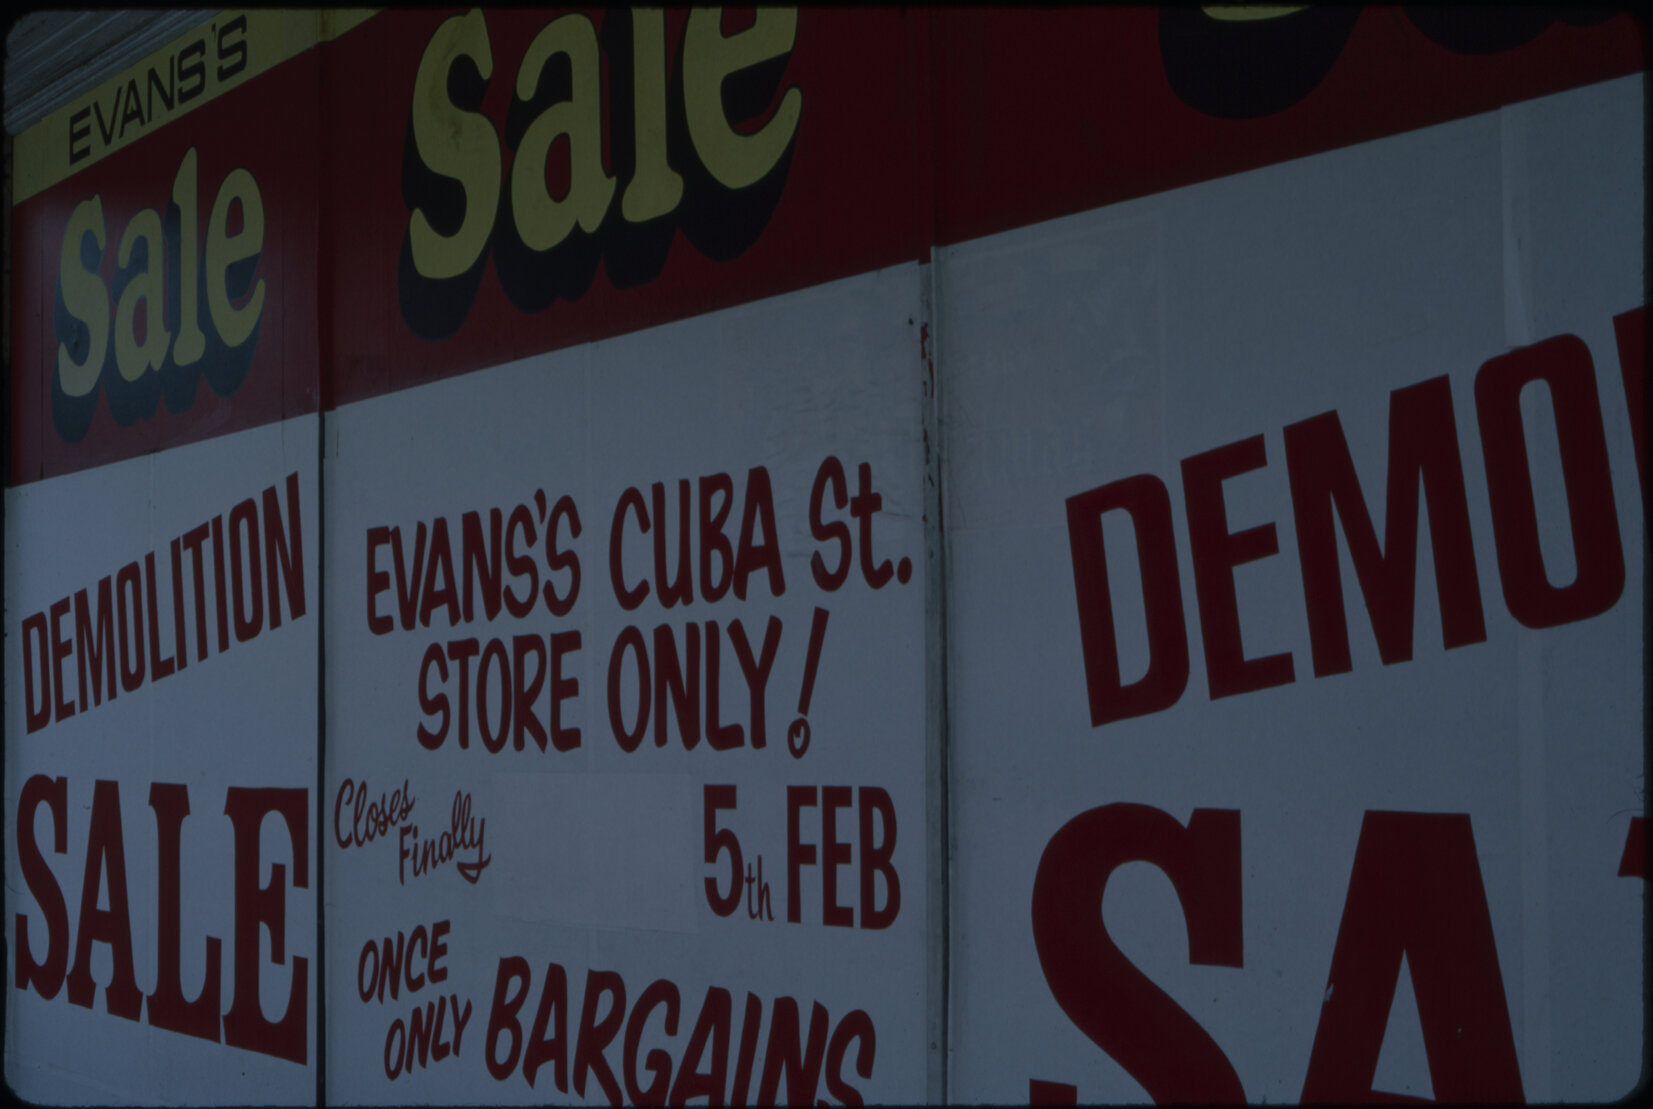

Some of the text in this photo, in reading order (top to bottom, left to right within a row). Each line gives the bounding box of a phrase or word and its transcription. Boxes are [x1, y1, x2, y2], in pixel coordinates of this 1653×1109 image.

[69, 14, 248, 166] EVANS'S
[408, 7, 802, 280] Sale
[57, 146, 266, 398] Sale
[367, 456, 912, 635] EVANS'S CUBA St.
[1066, 304, 1647, 727] DEMO
[21, 471, 306, 735] DEMOLITION
[417, 606, 829, 759] STORE ONLY!
[334, 778, 416, 849] Closes
[398, 790, 492, 886] Finally
[704, 784, 901, 930] 5th FEB
[15, 774, 309, 1066] SALE
[358, 920, 450, 1005] ONCE
[1030, 802, 1647, 1107] SA
[384, 994, 472, 1081] ONLY
[485, 956, 877, 1107] BARGAINS
